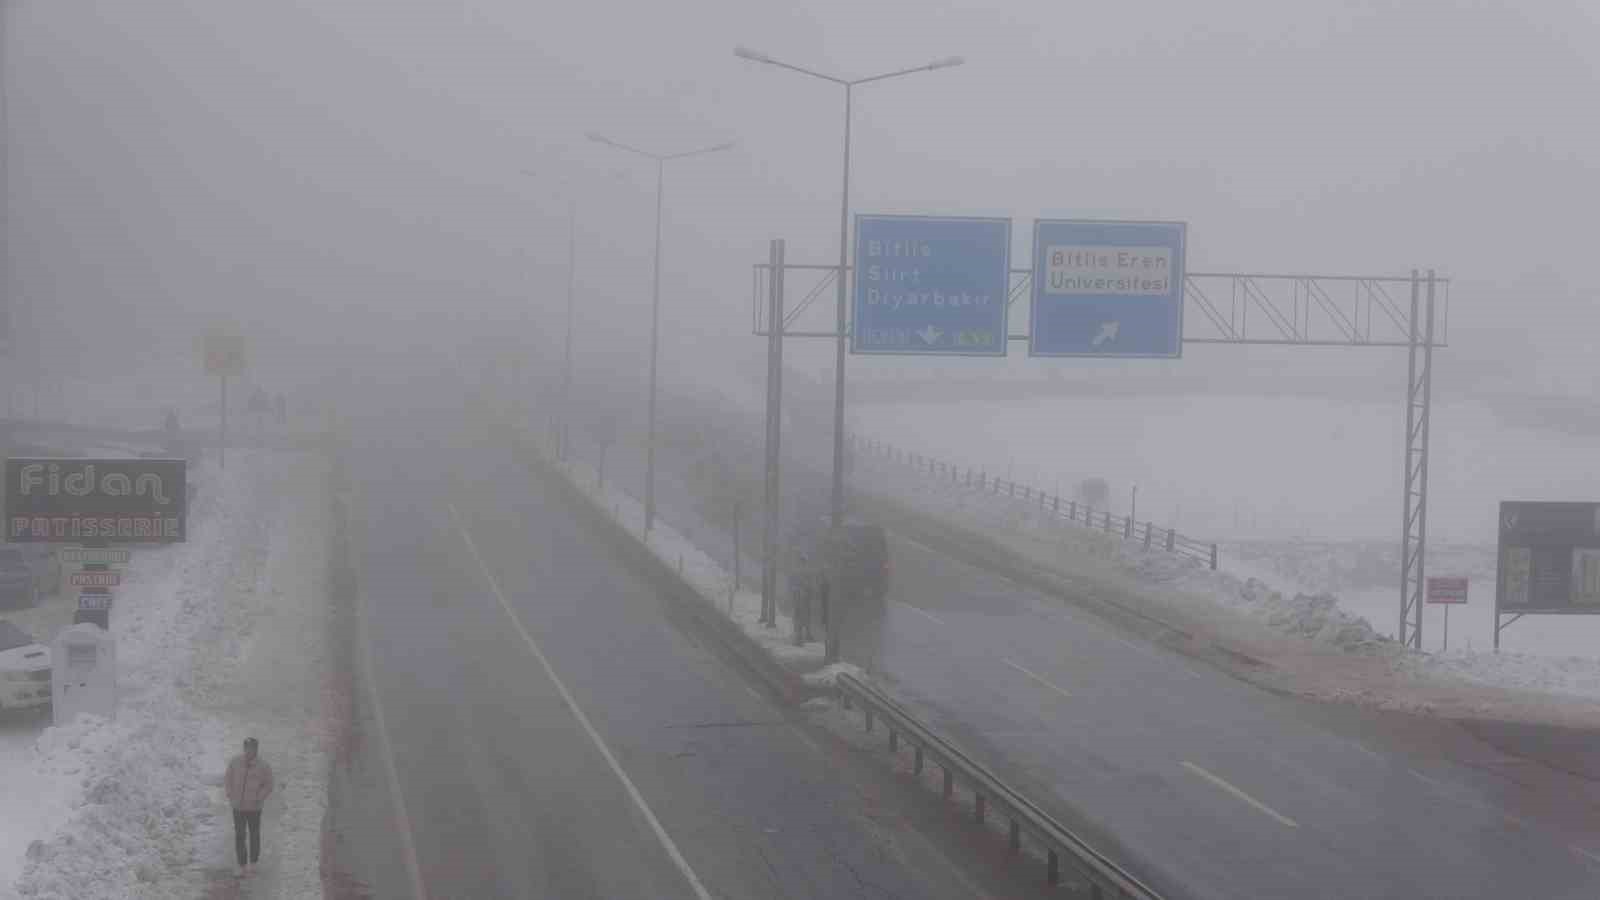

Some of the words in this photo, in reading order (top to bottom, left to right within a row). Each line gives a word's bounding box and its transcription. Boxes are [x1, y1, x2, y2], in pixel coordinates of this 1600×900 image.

[867, 240, 931, 256] Bitlis
[1051, 251, 1108, 268] Bitlis
[1117, 252, 1167, 270] Eren
[20, 463, 171, 504] Fidan
